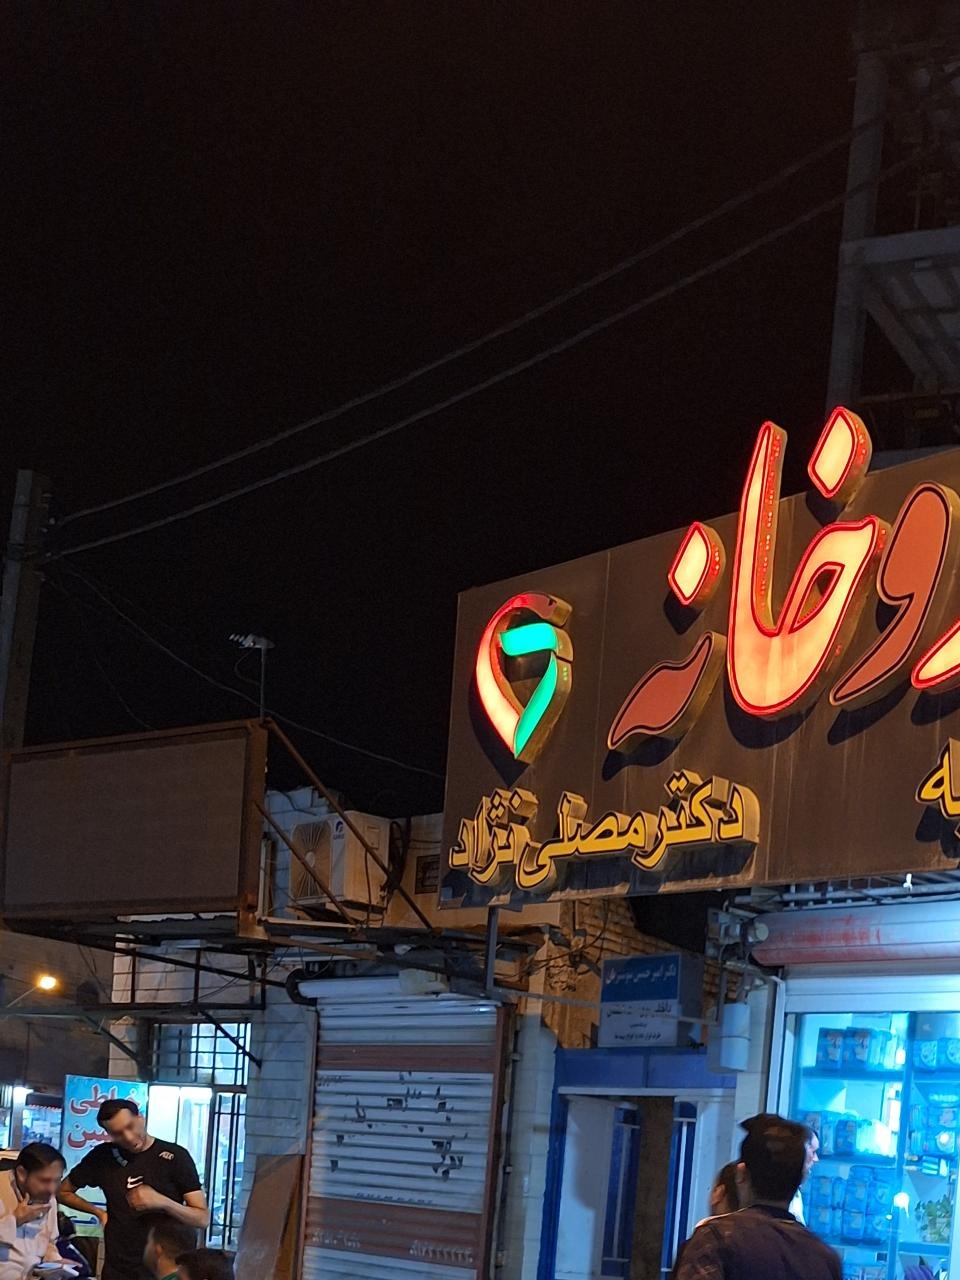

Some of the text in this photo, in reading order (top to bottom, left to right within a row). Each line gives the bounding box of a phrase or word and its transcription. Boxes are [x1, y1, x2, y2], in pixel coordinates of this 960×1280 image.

[448, 769, 752, 890] دکتر مصلی نژاد
